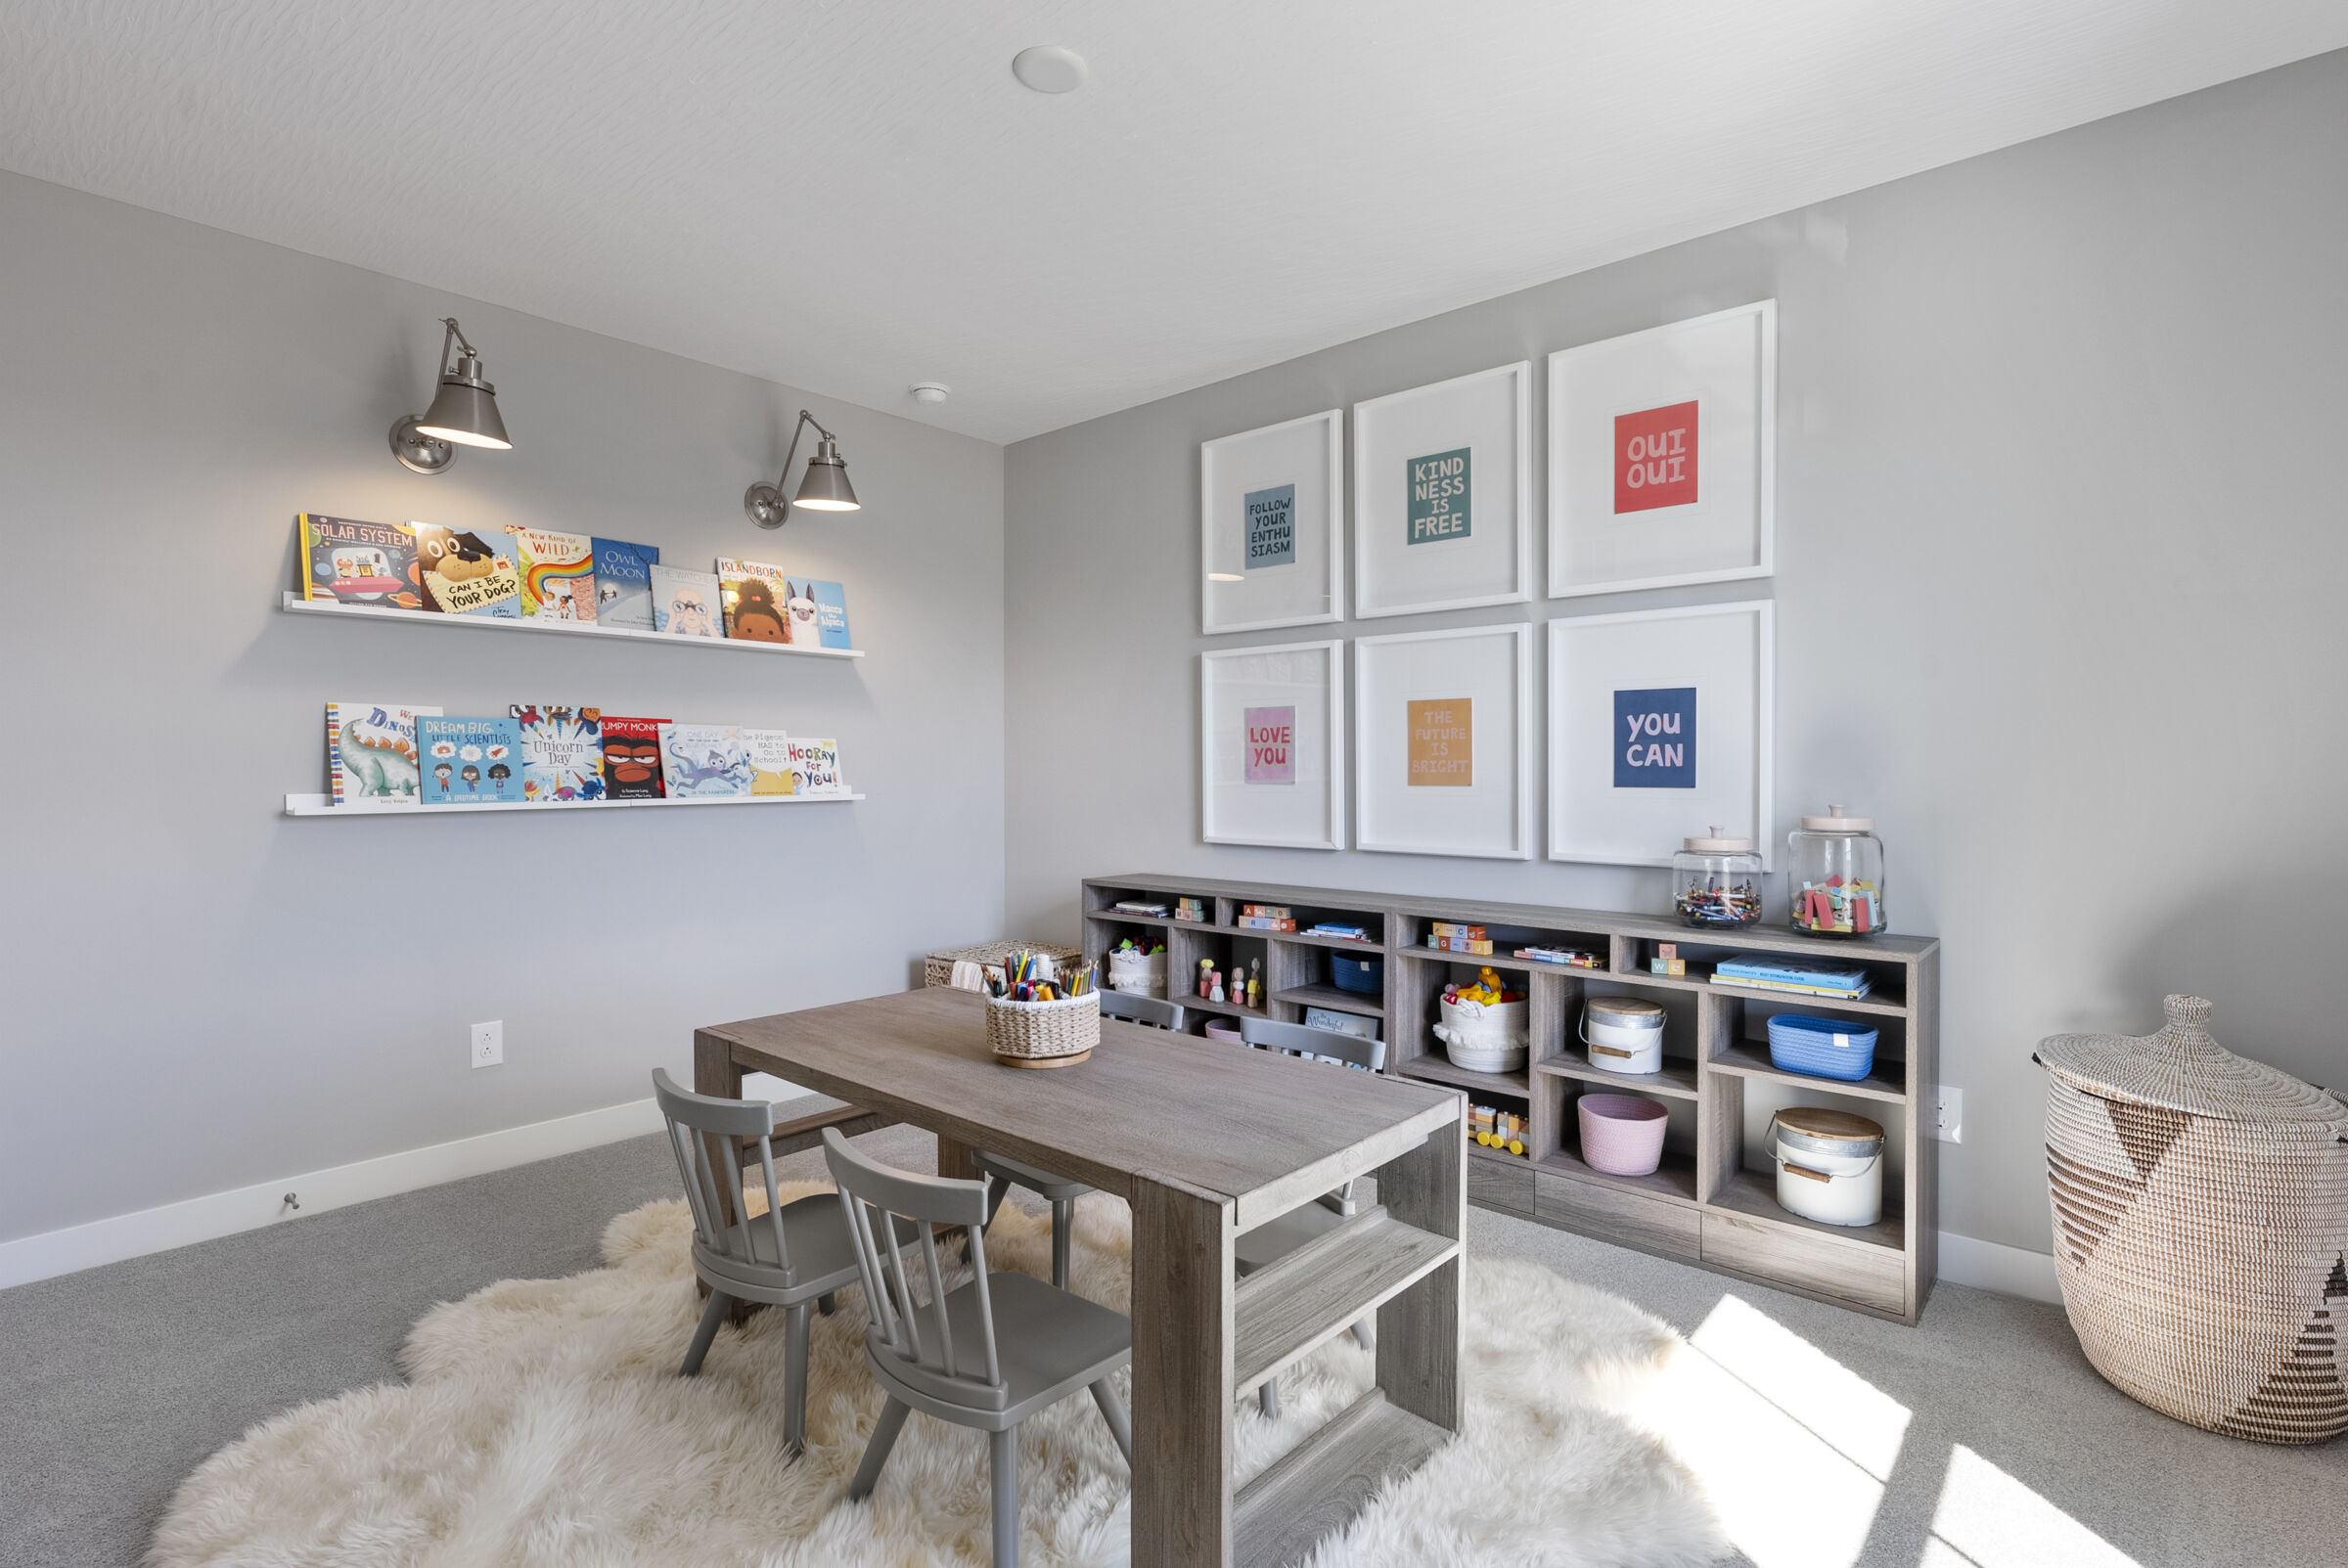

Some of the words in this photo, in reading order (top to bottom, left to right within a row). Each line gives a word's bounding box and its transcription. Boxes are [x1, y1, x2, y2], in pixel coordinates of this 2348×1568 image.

[1627, 427, 1687, 462] OUI
[1415, 457, 1465, 482] KIND
[1626, 456, 1686, 489] OUI
[1415, 476, 1465, 501] NESS
[1249, 497, 1291, 515] FOLLOW
[1431, 498, 1449, 515] IS
[1255, 512, 1287, 530] YOUR
[1414, 513, 1464, 539] FREE
[312, 523, 355, 540] SOLAR
[360, 528, 413, 547] SYSTEM
[1251, 526, 1290, 543] ENTHU
[532, 541, 569, 556] WILD
[1250, 540, 1290, 558] SIASM
[720, 561, 783, 580] ISLANDBORN
[446, 592, 482, 609] YOUR
[485, 579, 516, 600] DOG?
[448, 583, 472, 595] CAN
[485, 575, 501, 587] BE
[1424, 711, 1453, 724] THE
[425, 721, 466, 734] DREAM
[1249, 726, 1290, 743] LOVE
[1416, 727, 1467, 740] FUTURE
[1626, 712, 1681, 742] YOU
[431, 734, 462, 742] LITTLE
[464, 734, 512, 745] SCIENTISTS
[533, 739, 584, 754] Unicorn
[1254, 746, 1287, 767] YOU
[1431, 742, 1449, 756] IS
[1626, 743, 1684, 767] CAN
[548, 752, 572, 766] Day
[1412, 759, 1470, 774] BRIGHT
